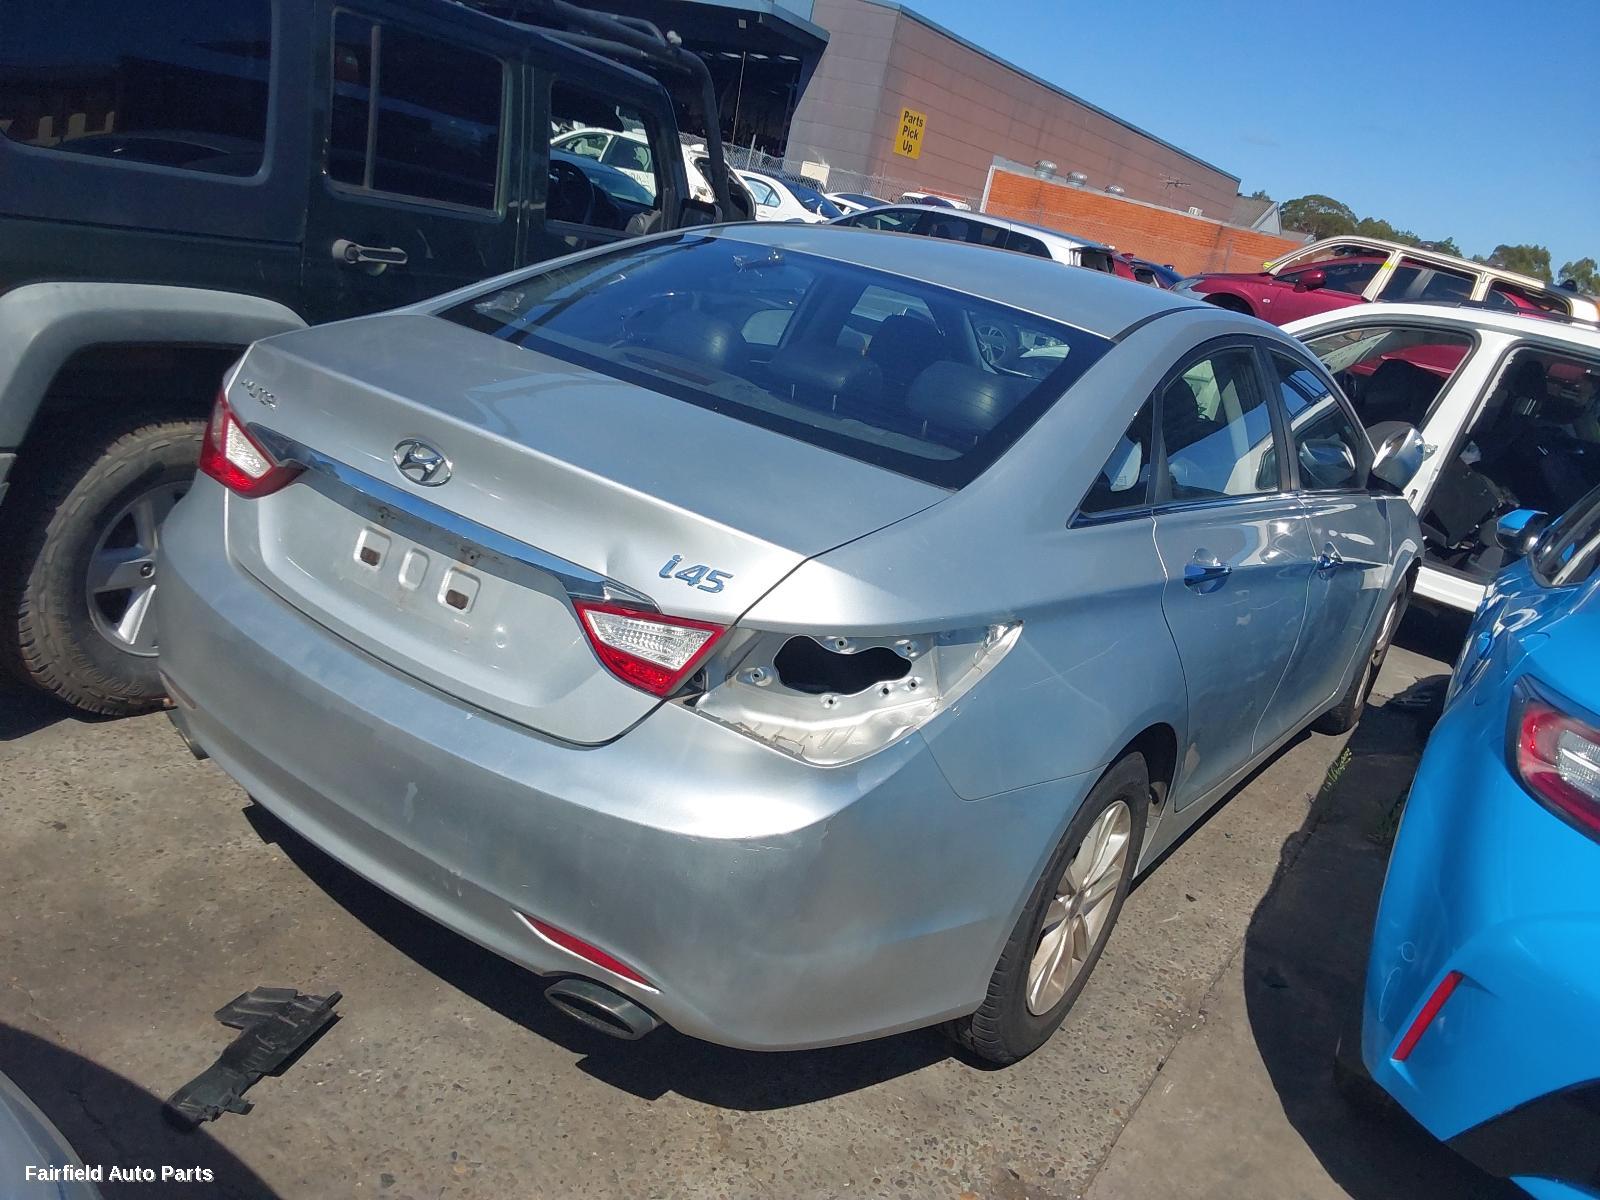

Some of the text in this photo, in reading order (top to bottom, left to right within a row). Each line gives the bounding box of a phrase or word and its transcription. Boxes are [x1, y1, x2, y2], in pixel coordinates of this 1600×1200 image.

[903, 110, 924, 128] Parts
[902, 125, 919, 140] Pick
[902, 139, 913, 155] Up
[659, 554, 734, 593] i45
